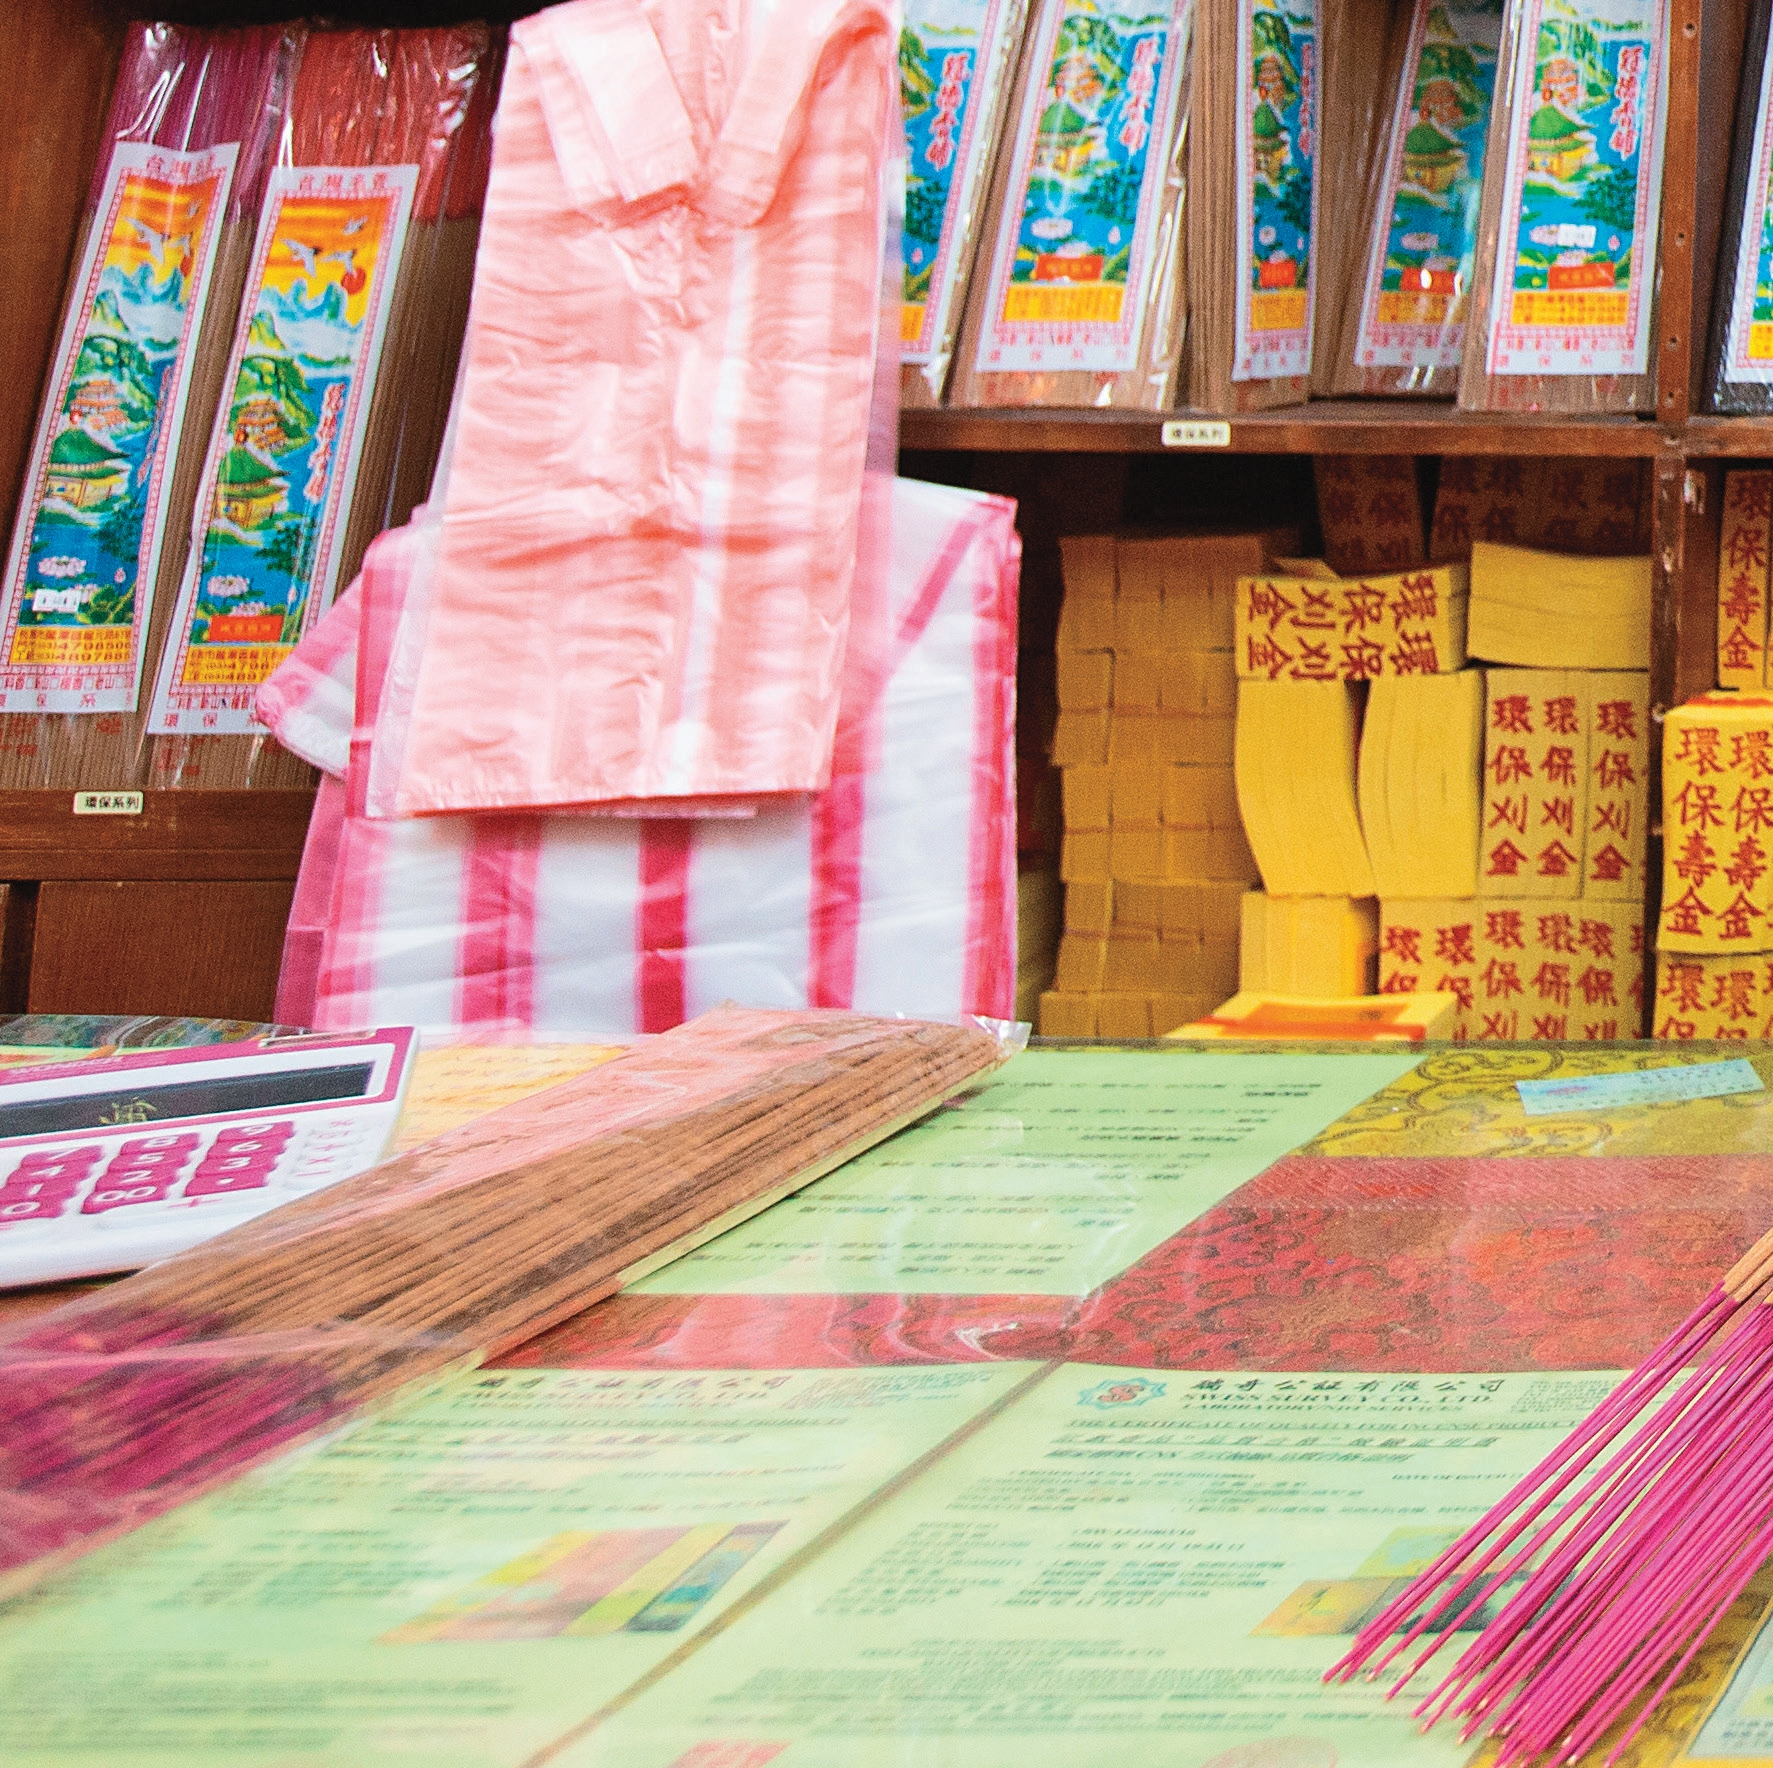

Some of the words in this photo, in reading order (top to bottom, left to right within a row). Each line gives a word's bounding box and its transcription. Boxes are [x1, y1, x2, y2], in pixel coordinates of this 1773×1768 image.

[1616, 42, 1650, 160] 冠德香舖
[1721, 474, 1772, 671] 環保壽金
[84, 795, 141, 810] 環保系列
[1486, 694, 1534, 876] 環保刈金
[1538, 695, 1579, 876] 環保刈金
[1591, 700, 1638, 881] 環保刈金
[1667, 726, 1727, 936] 環保壽金
[1067, 1419, 1104, 1431] THE
[1181, 1392, 1262, 1405] SWISS
[1266, 1392, 1390, 1405] SURVEY
